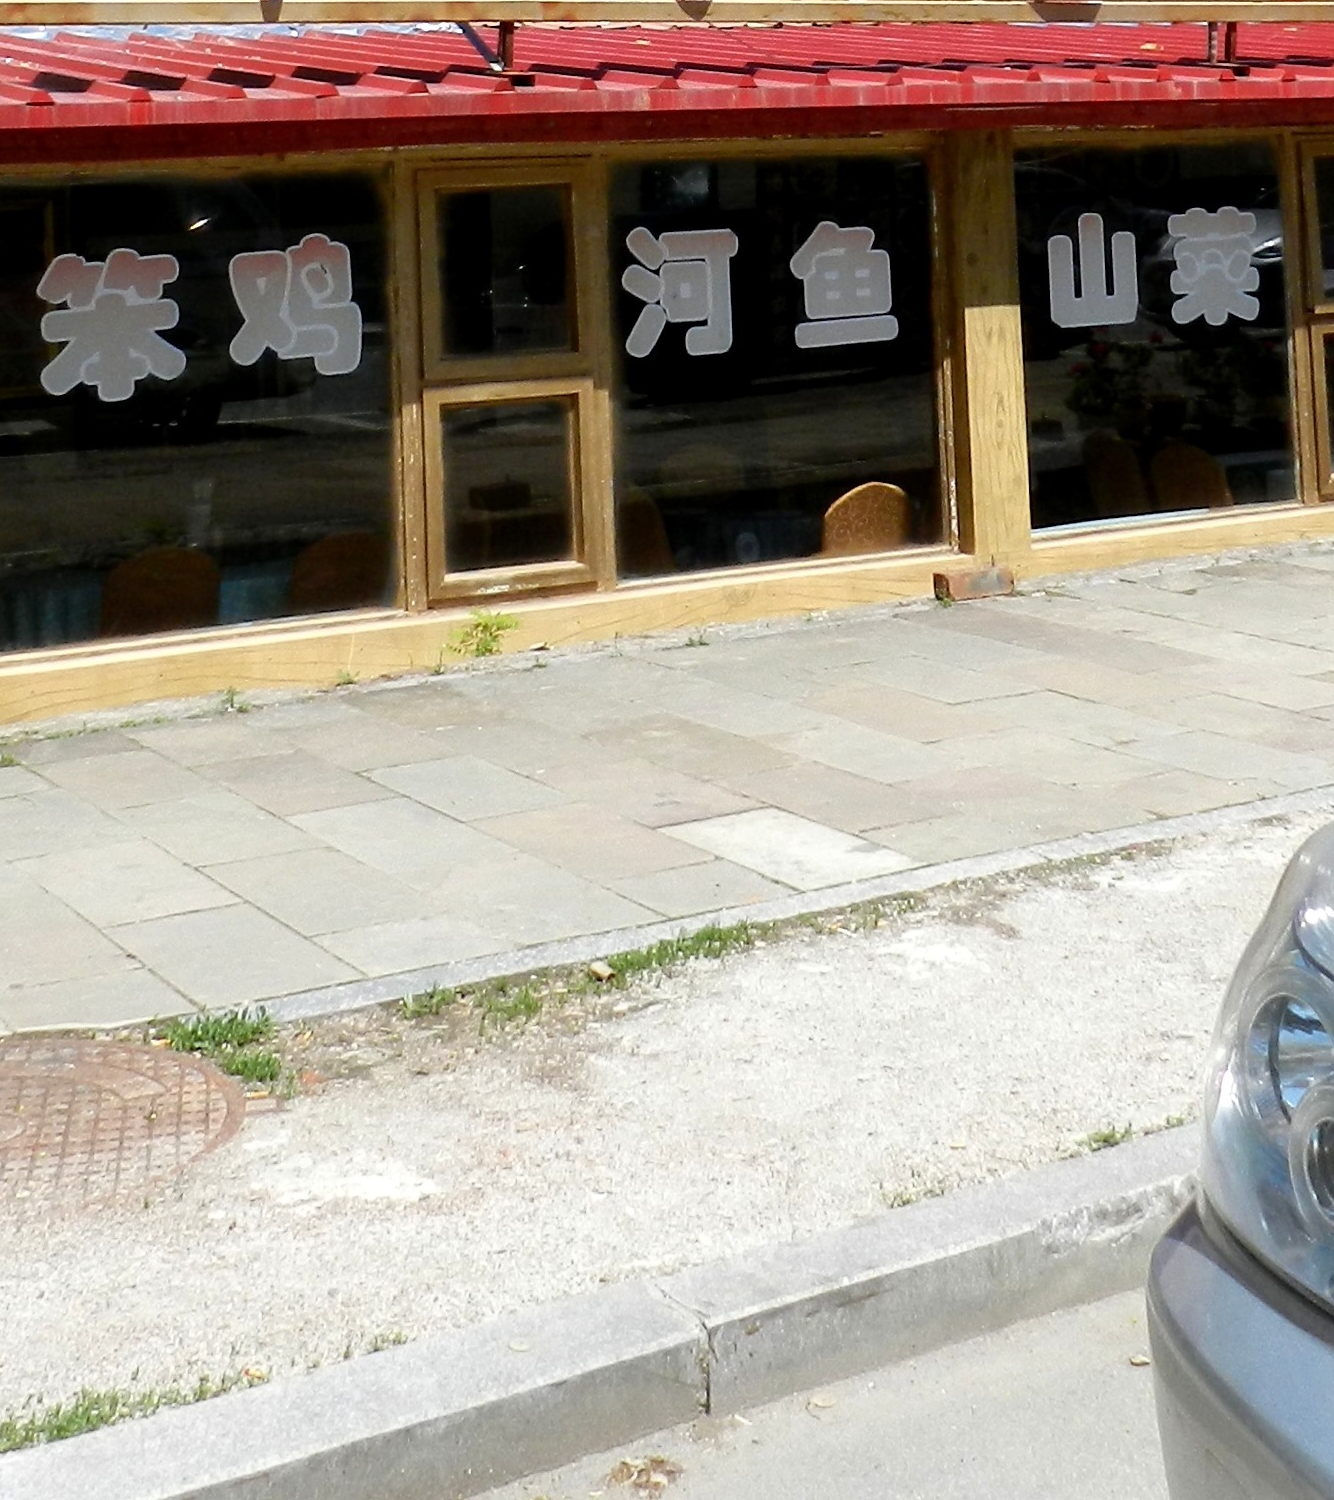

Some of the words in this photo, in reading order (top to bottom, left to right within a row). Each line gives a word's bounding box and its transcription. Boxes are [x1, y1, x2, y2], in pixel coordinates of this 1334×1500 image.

[36, 233, 363, 402] 笨鸡
[622, 221, 899, 357] 河鱼
[1048, 206, 1260, 327] 山菜
